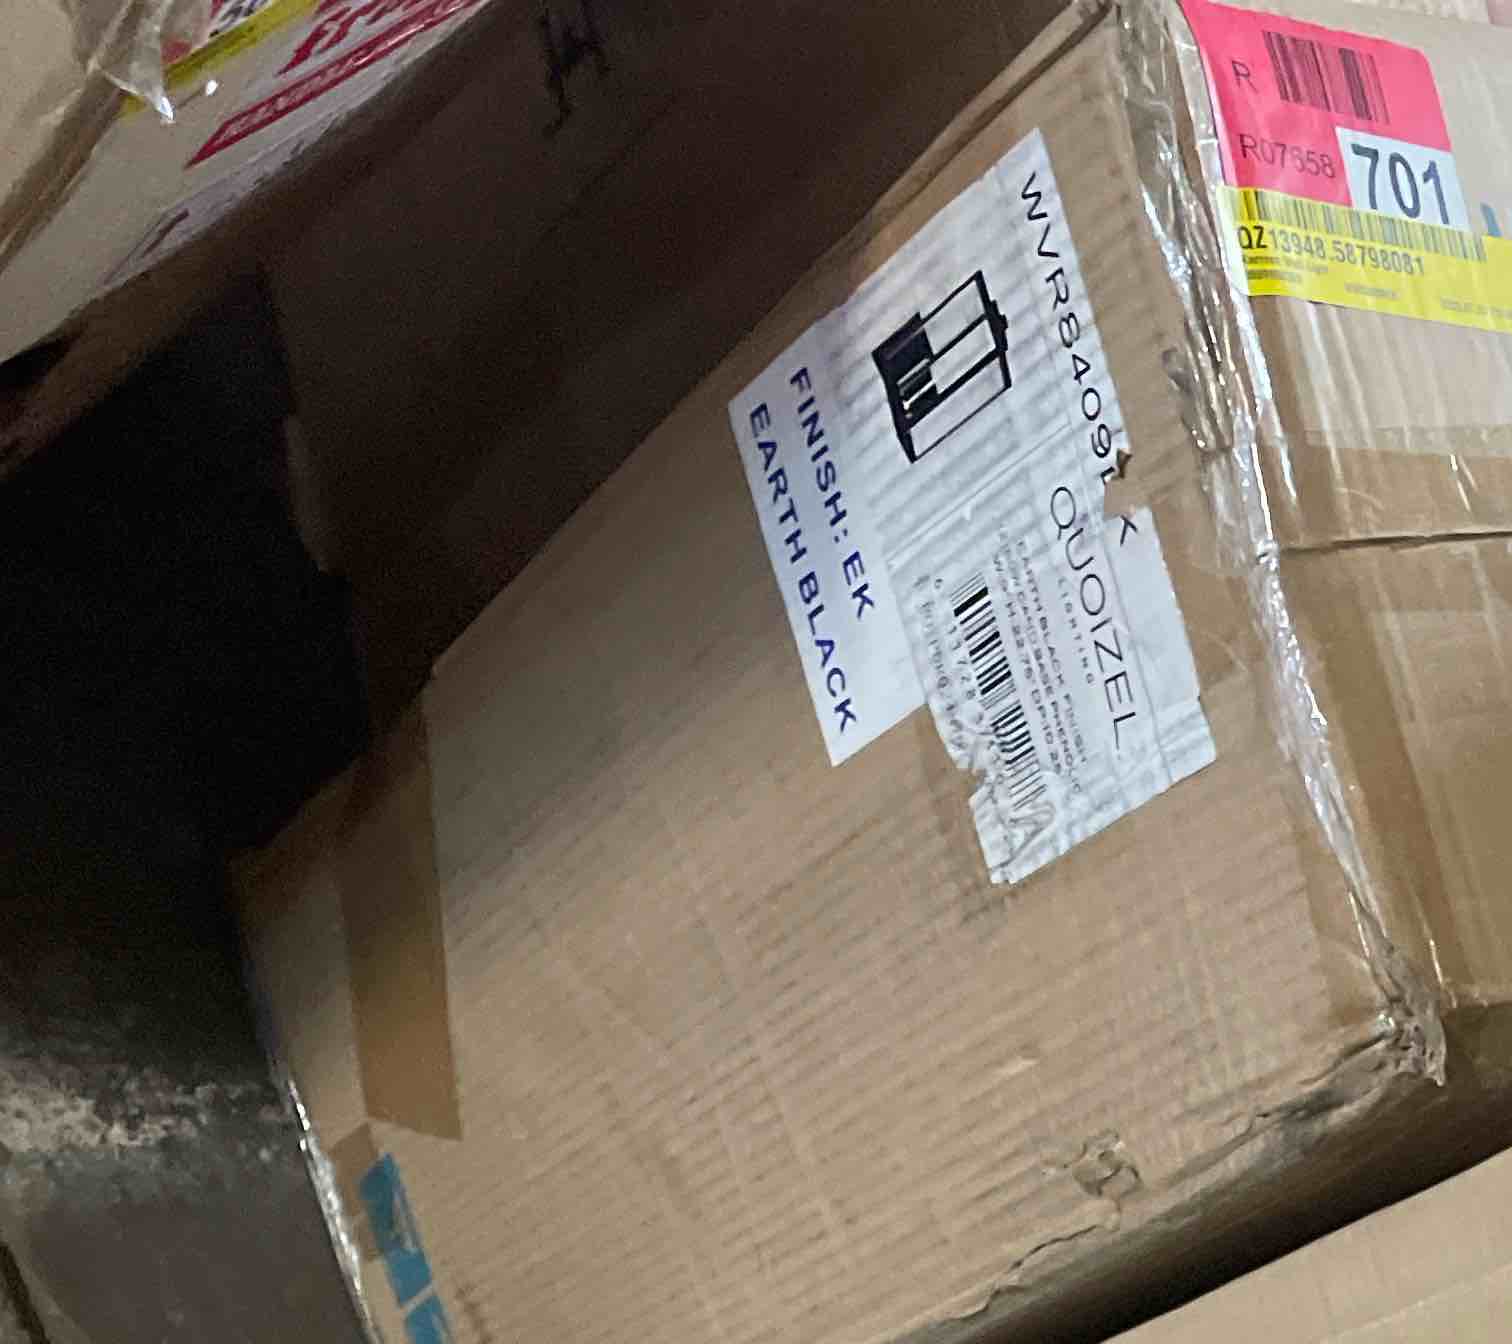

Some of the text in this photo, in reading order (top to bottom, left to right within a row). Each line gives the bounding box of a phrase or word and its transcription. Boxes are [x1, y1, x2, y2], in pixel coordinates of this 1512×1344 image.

[1350, 143, 1451, 226] 701
[749, 403, 857, 731] EARTH BLACK
[790, 366, 875, 621] FINISH: EK
[1050, 486, 1136, 751] QUOIZEL
